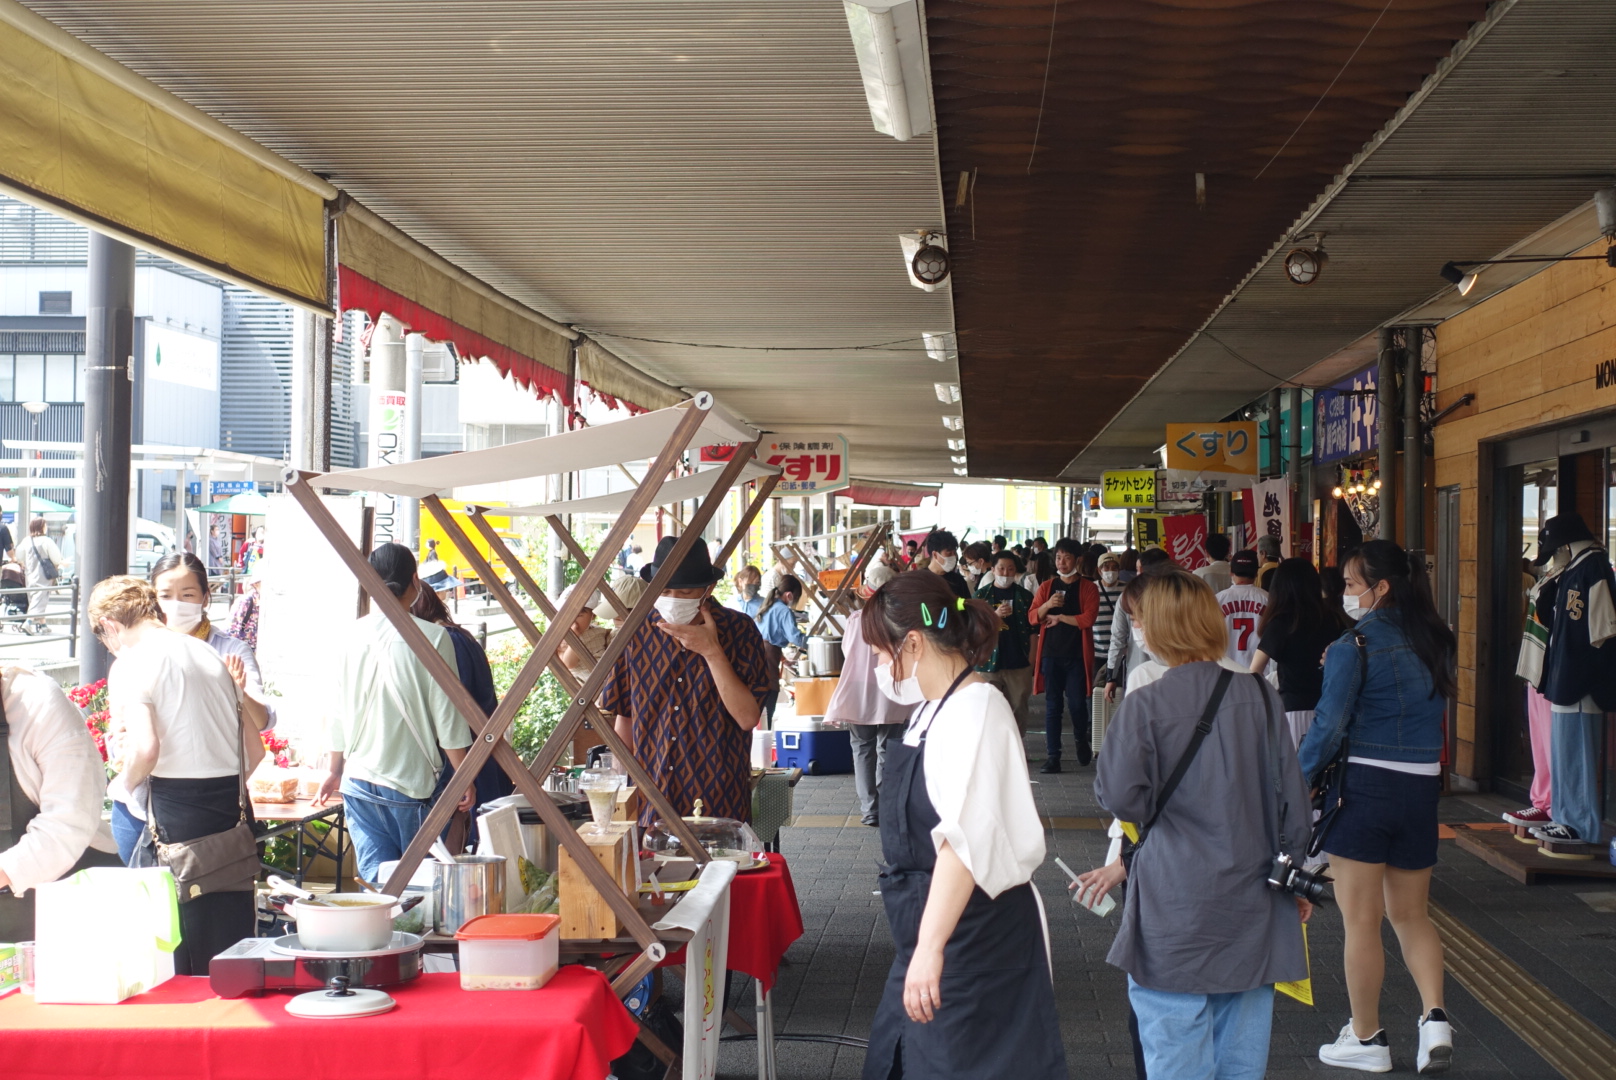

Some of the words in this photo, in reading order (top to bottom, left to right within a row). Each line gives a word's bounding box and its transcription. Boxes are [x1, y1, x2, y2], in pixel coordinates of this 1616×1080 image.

[778, 442, 834, 451] 保険調剤
[1176, 429, 1248, 458] くすり
[1105, 476, 1155, 491] チケットセンタ
[1123, 494, 1155, 503] 駅前店
[1233, 618, 1255, 651] 7
